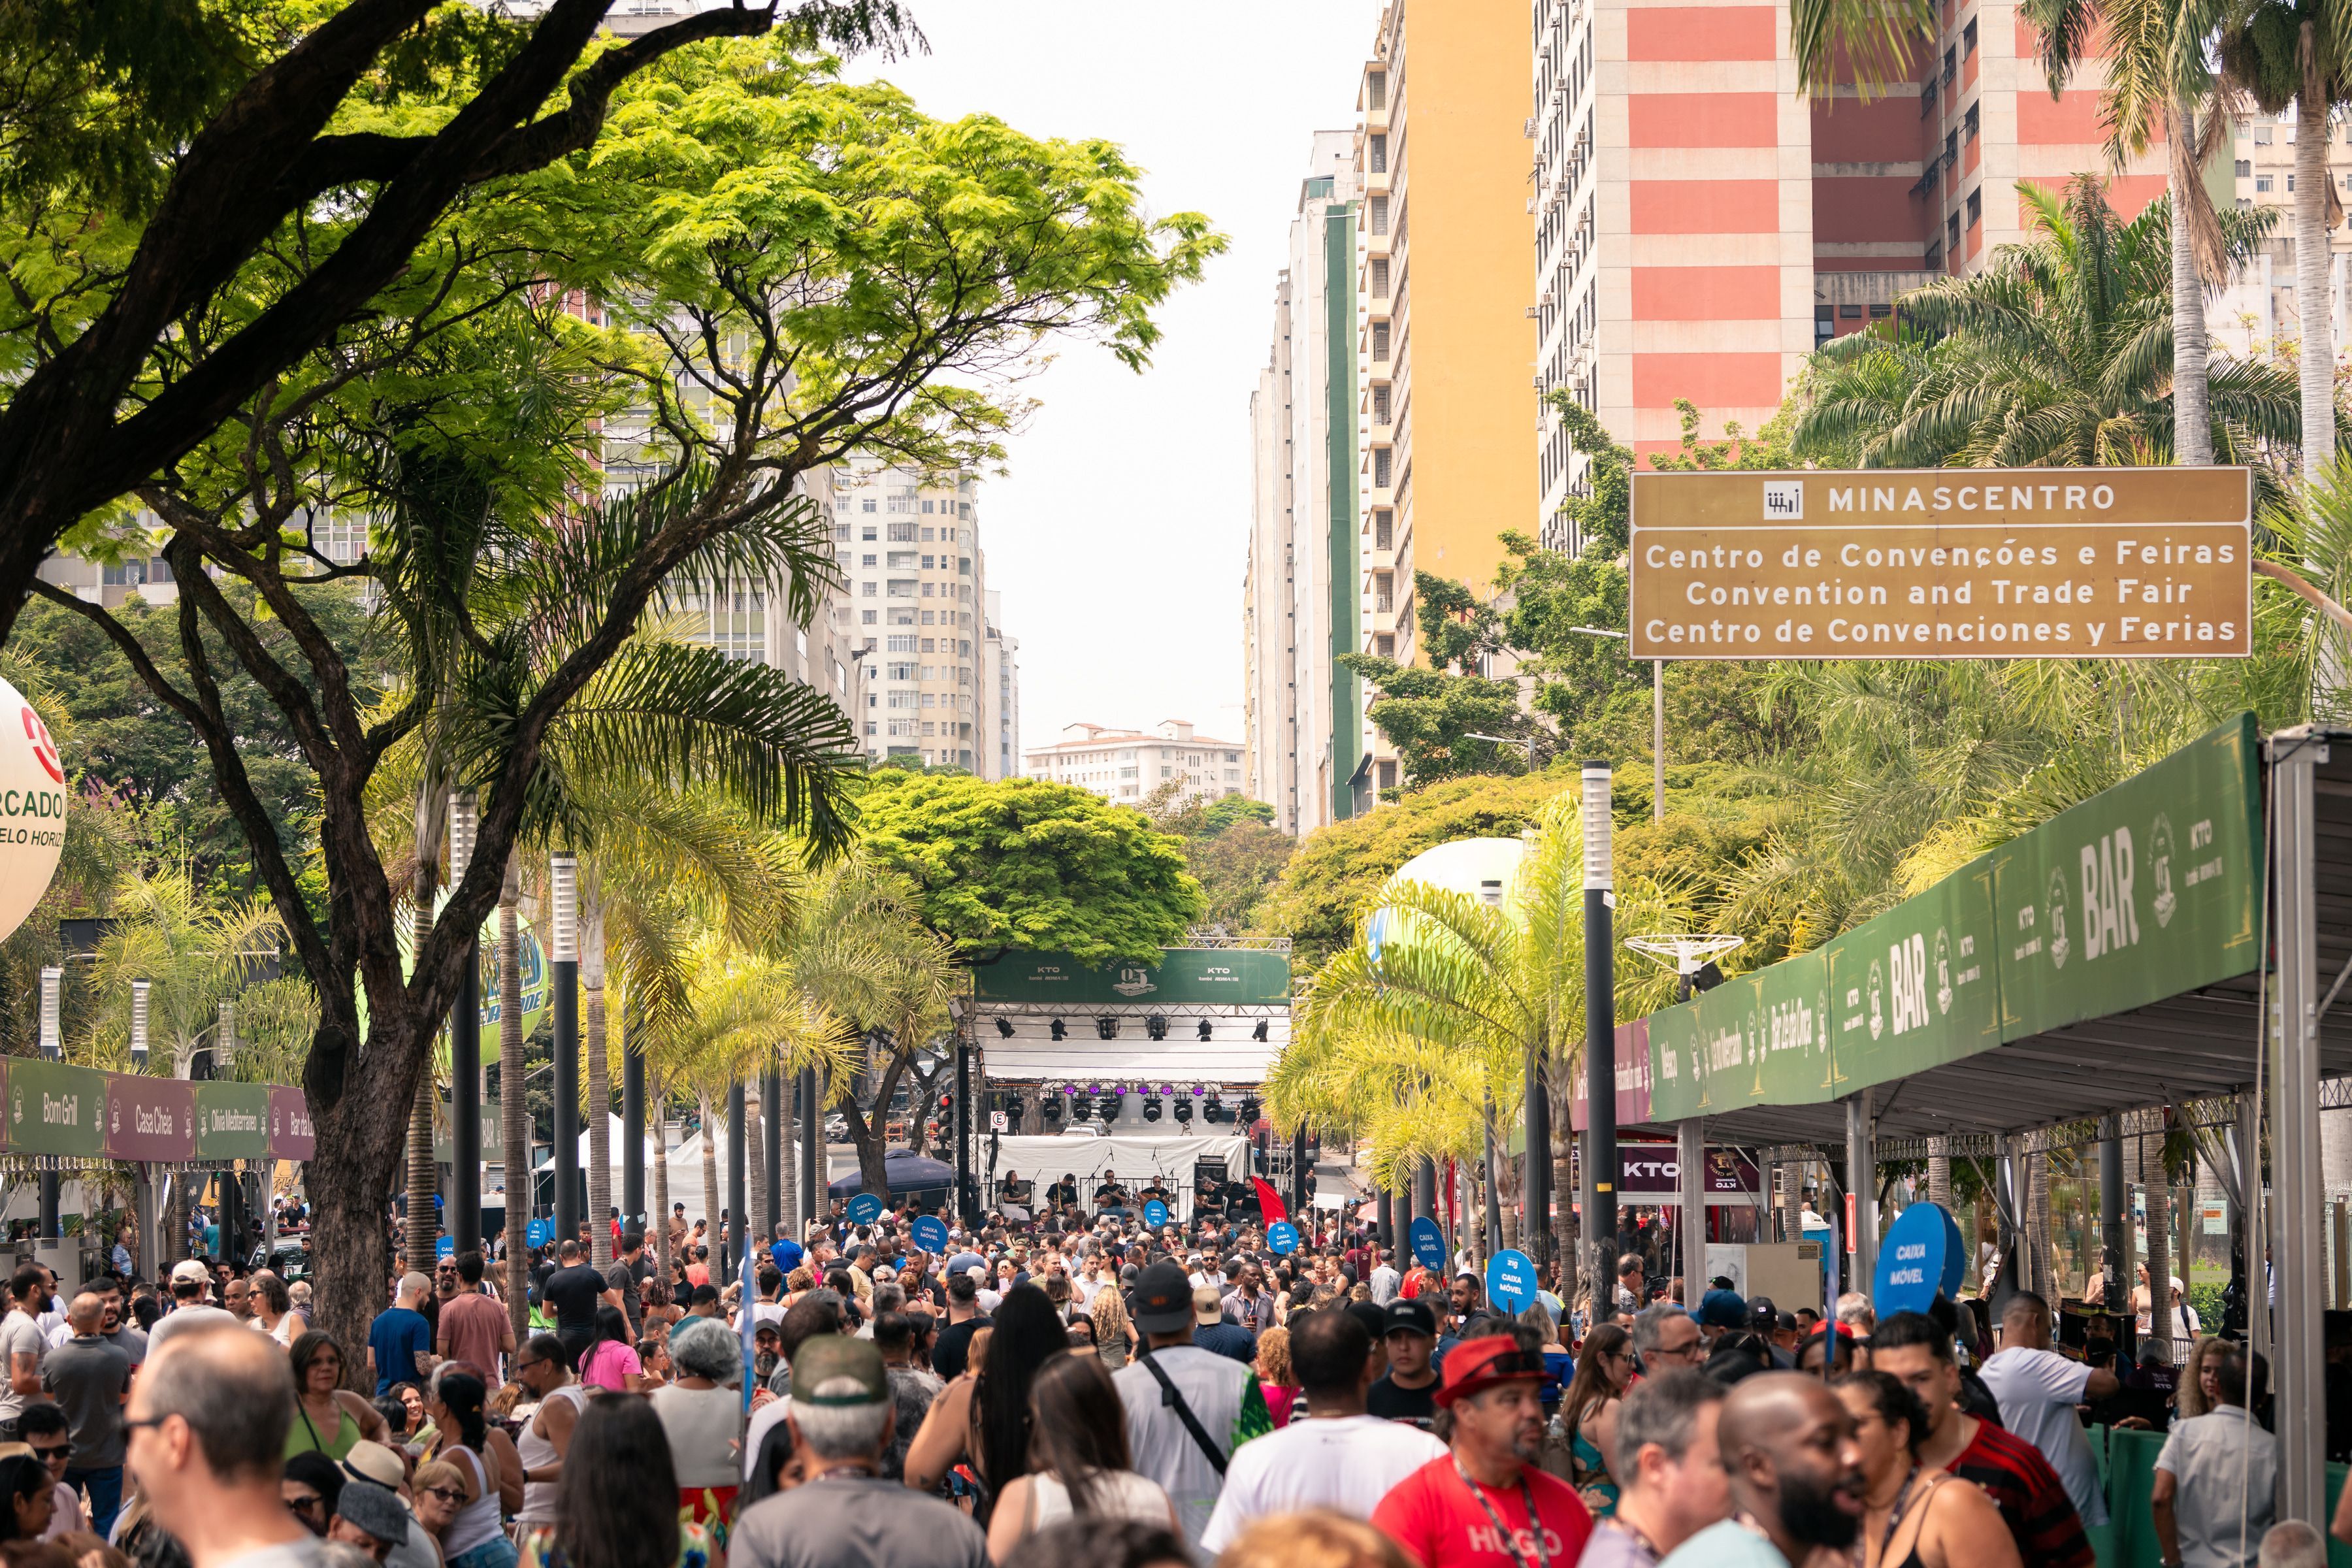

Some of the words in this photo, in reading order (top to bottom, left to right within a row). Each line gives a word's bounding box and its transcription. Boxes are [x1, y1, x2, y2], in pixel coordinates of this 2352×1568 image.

[1829, 485, 2114, 512] MINASCENTRO
[1646, 544, 1763, 568] Centro
[1782, 544, 1821, 568] de
[2078, 546, 2096, 565] e
[2117, 537, 2234, 564] Feiras
[1686, 578, 1887, 606] Convention
[1908, 580, 1971, 604] and
[1991, 580, 2094, 604] Trade
[2118, 577, 2193, 604] Fair
[1645, 619, 1761, 643] Centro
[1774, 619, 1813, 642] de
[1828, 612, 2071, 642] Convenciones
[2087, 622, 2106, 647] y
[2121, 614, 2235, 642] Ferias
[0, 789, 62, 819] CADO
[2190, 819, 2212, 851] KTO
[2081, 825, 2140, 961] BAR
[2017, 904, 2034, 931] KTO
[1960, 935, 1974, 958] KTO
[1890, 932, 1929, 1036] BAR
[1846, 987, 1859, 1009] KTO
[1771, 1005, 1782, 1051] Bar
[43, 1092, 61, 1124] Bom
[62, 1094, 78, 1126] Grill
[136, 1104, 154, 1135] Casa
[154, 1105, 172, 1135] Cheia
[225, 1108, 257, 1132] Mediterrâneo
[997, 1114, 1002, 1123] E
[291, 1111, 301, 1136] Bar
[301, 1112, 308, 1137] da
[482, 1118, 495, 1149] BAR
[1624, 1162, 1681, 1177] KTO
[857, 1202, 872, 1211] CAIXA
[857, 1207, 875, 1216] MÓVEL
[920, 1232, 939, 1241] MÓVEL
[921, 1226, 938, 1234] CAIXA
[1420, 1243, 1437, 1252] MÓVEL
[1896, 1243, 1926, 1261] CAIXA
[1507, 1260, 1518, 1269] zig
[1889, 1266, 1924, 1286] MÓVEL
[1499, 1282, 1523, 1296] MÓVEL
[1501, 1273, 1522, 1284] CAIXA
[1465, 1524, 1563, 1558] HUGO
